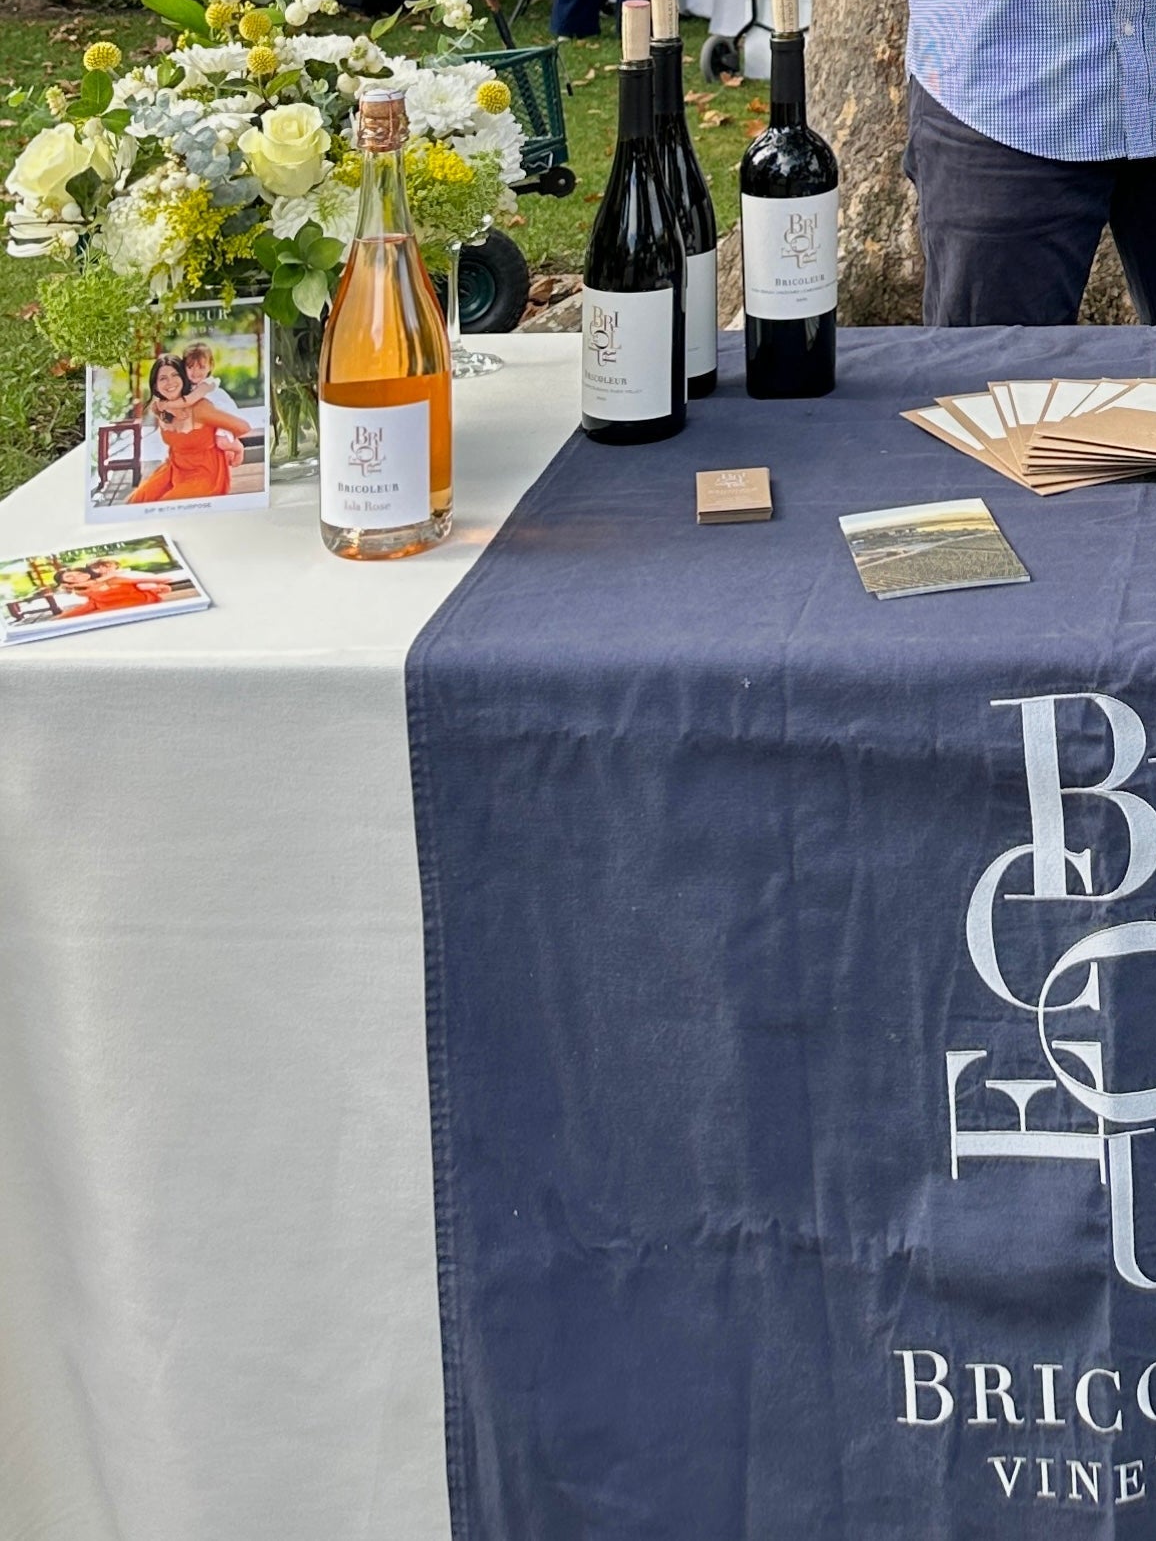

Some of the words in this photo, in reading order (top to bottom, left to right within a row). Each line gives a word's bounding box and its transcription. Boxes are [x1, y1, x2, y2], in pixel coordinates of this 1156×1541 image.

[775, 274, 825, 287] BRICOLEUR
[338, 482, 400, 494] BRICOLEUR
[177, 502, 213, 511] PURPOSE
